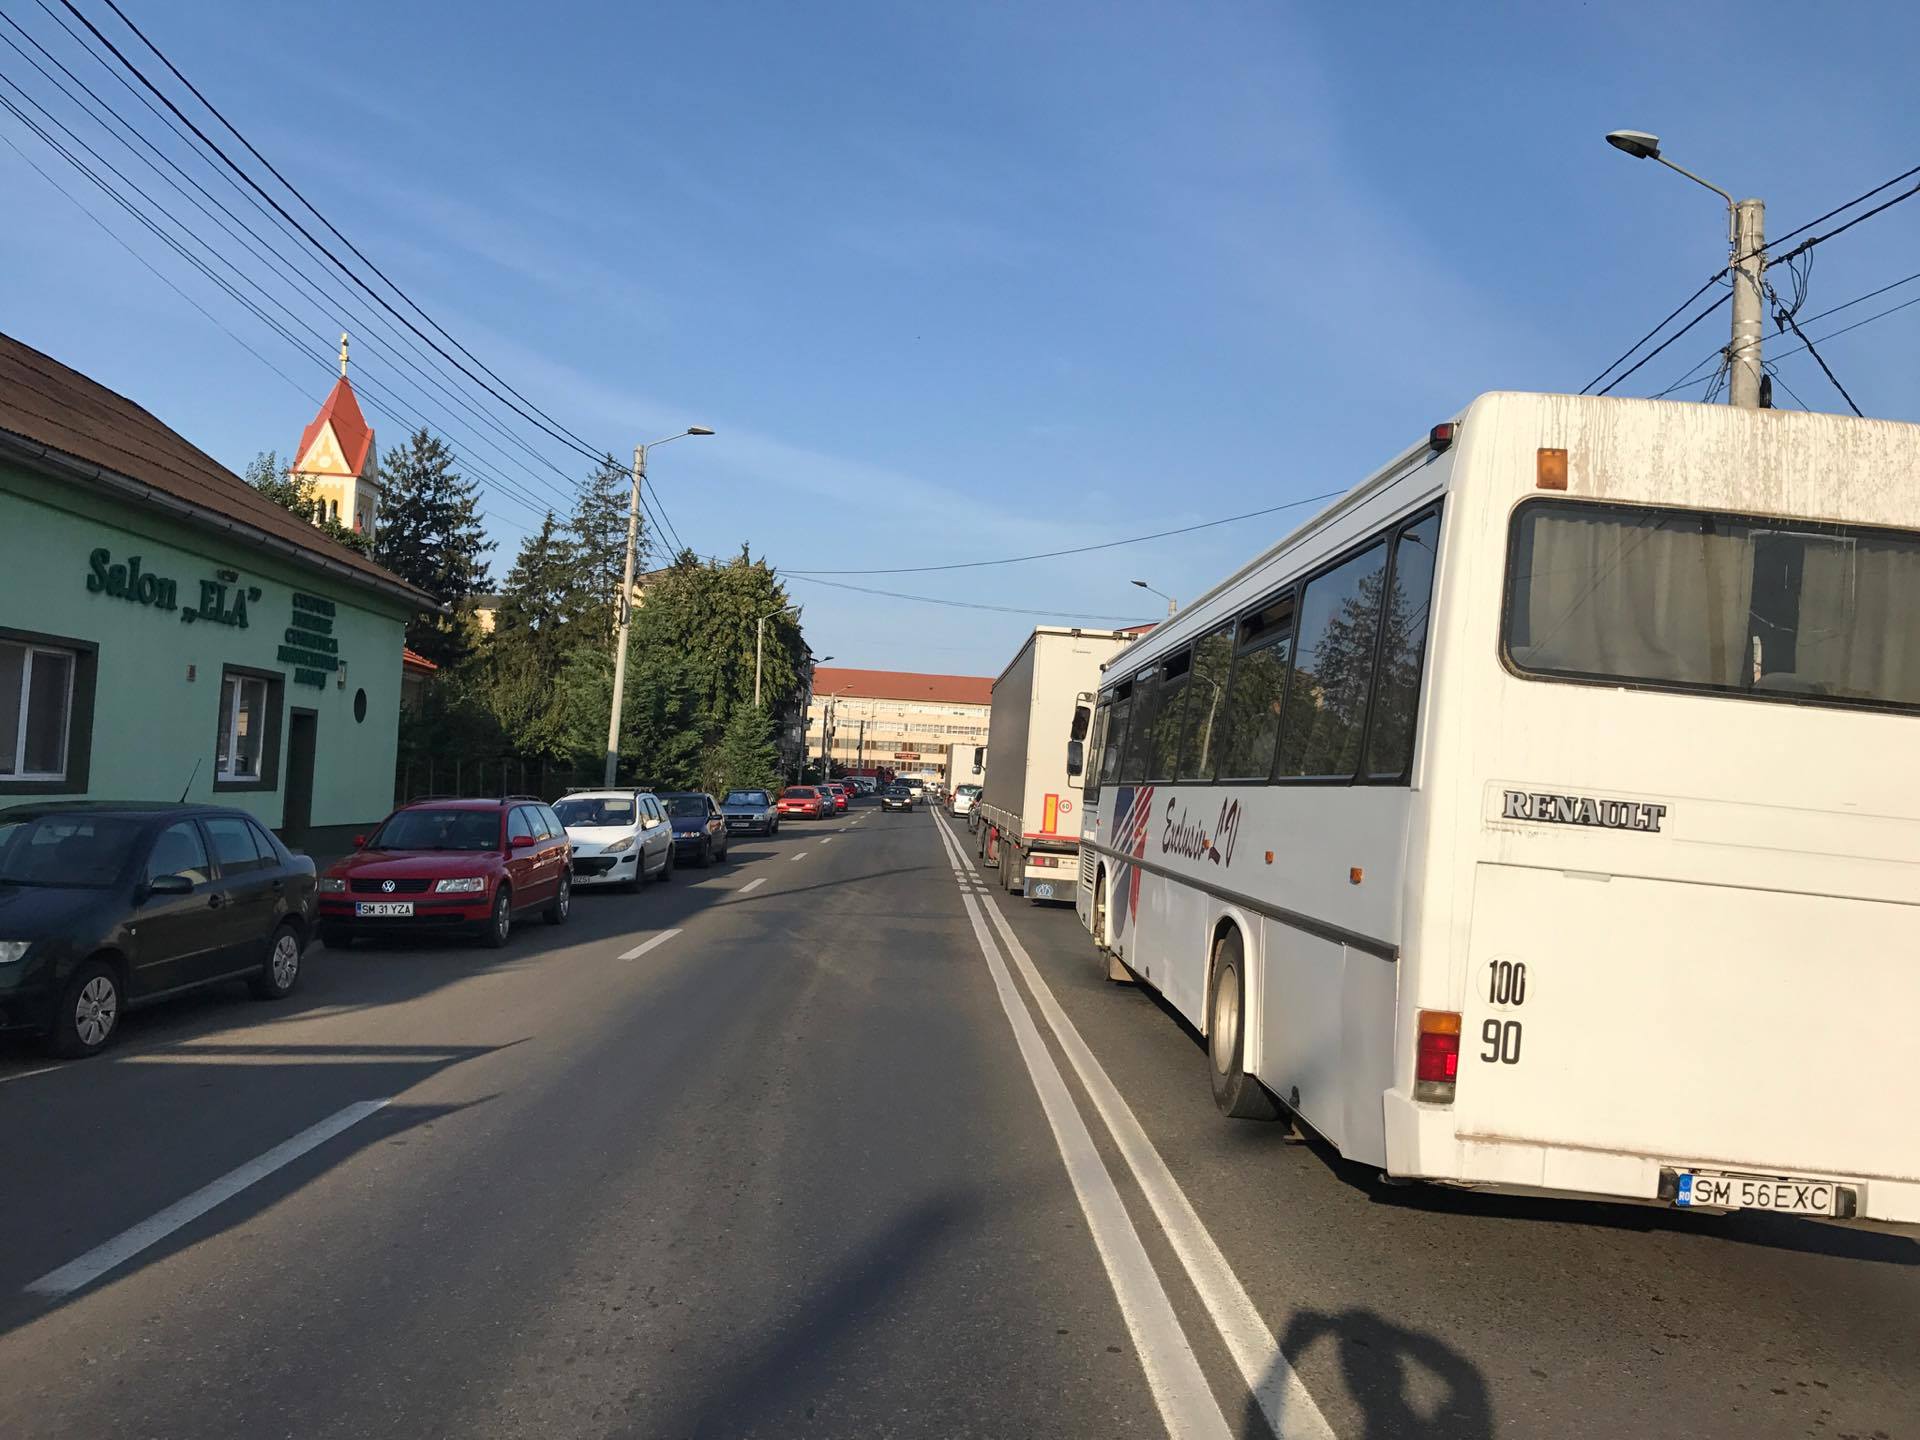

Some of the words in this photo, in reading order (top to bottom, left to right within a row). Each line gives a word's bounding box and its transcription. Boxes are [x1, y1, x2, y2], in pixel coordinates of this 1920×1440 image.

[87, 548, 178, 610] Salon
[1502, 790, 1667, 832] RENAULT
[362, 904, 375, 914] SM
[378, 904, 388, 914] 31
[390, 904, 411, 914] YZA
[1489, 960, 1526, 1006] 100
[1480, 1019, 1522, 1065] 90
[1695, 1179, 1731, 1205] SM
